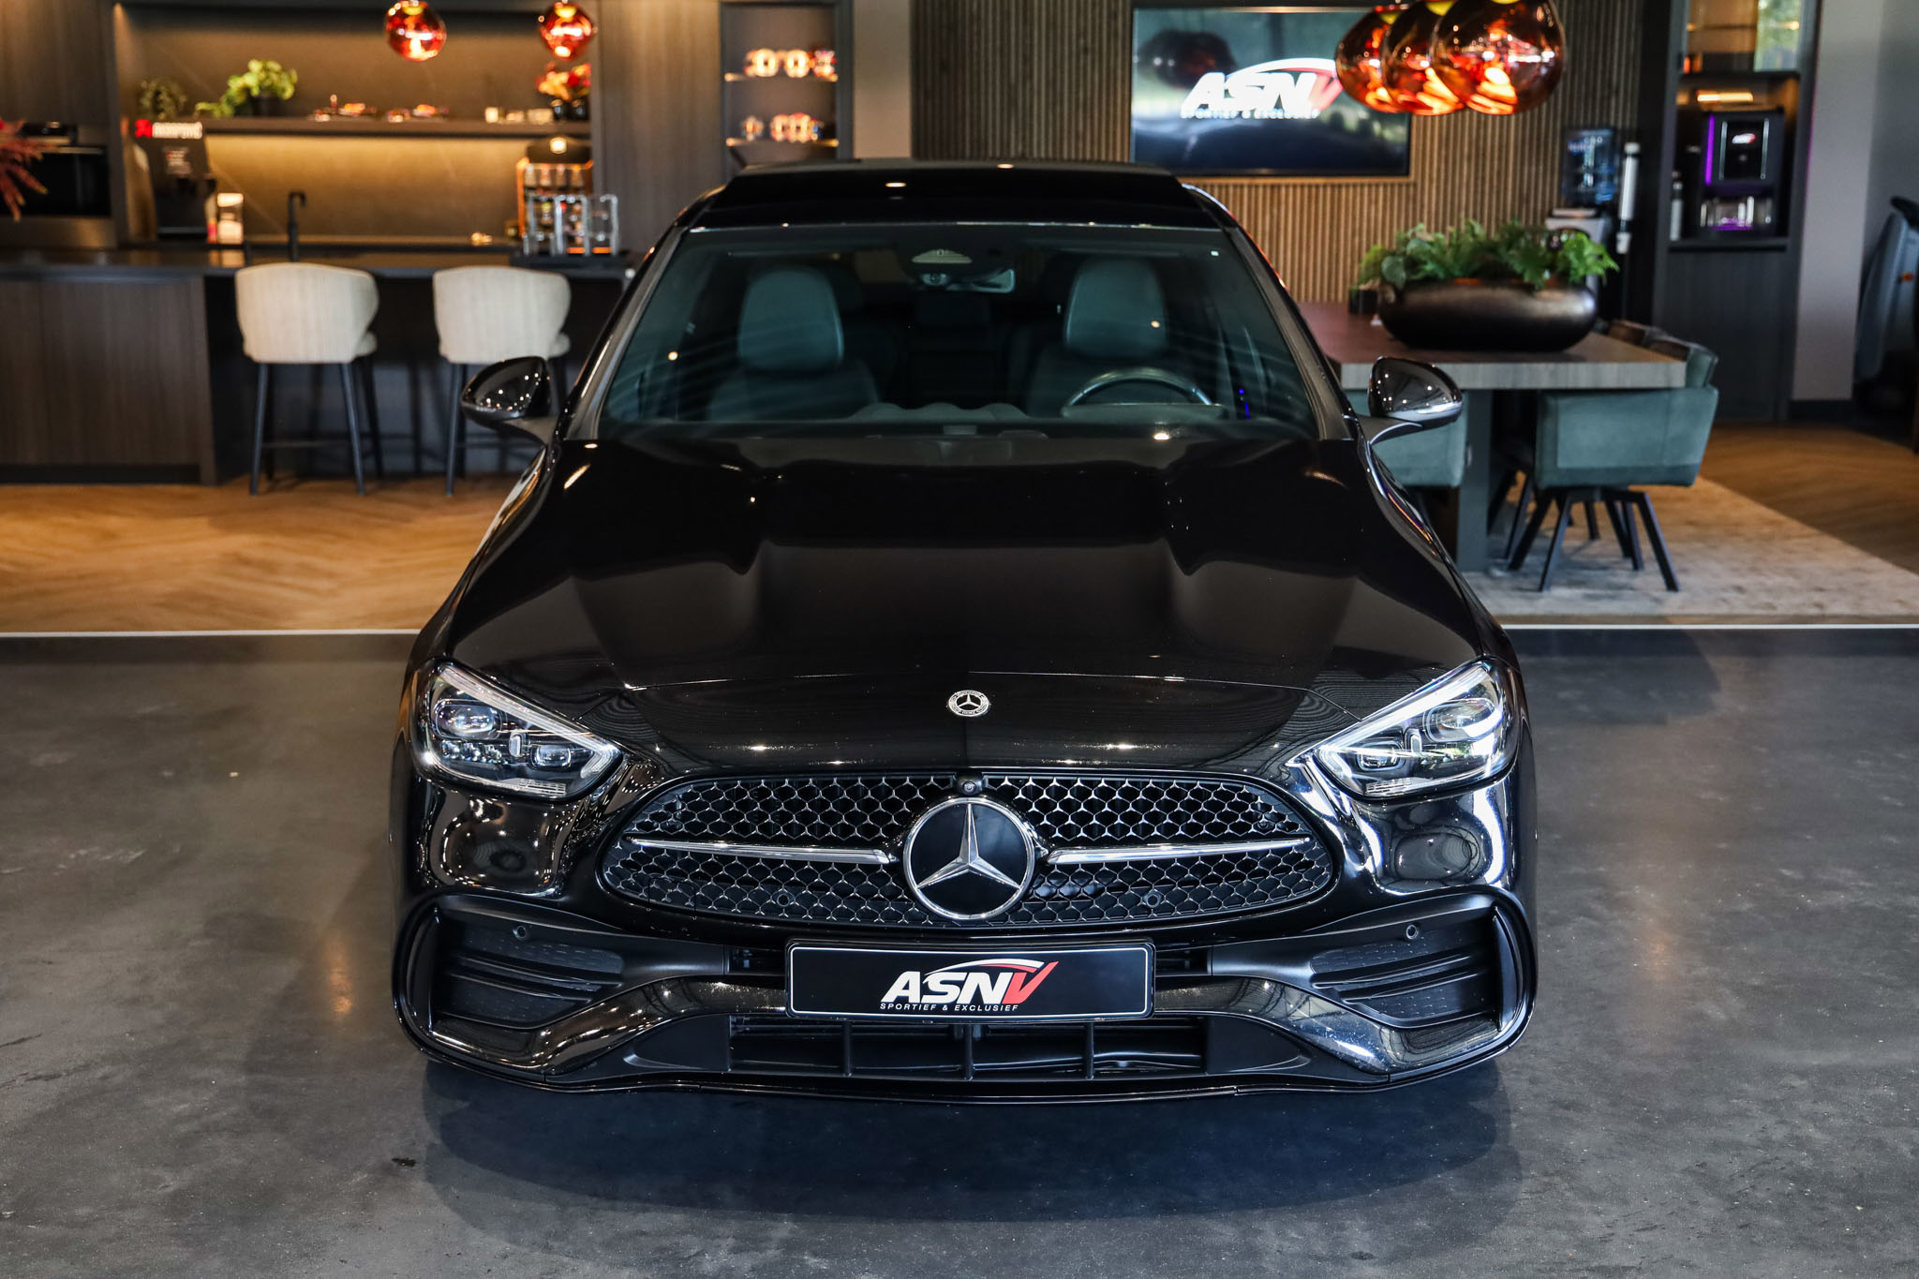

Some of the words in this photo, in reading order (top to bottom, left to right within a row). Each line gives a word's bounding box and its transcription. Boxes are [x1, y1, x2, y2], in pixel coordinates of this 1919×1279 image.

[1180, 66, 1343, 113] ASNV
[880, 960, 1060, 1005] ASNV
[879, 1002, 937, 1011] SPORTIEF
[954, 1004, 1019, 1012] EXCLUSIEF
